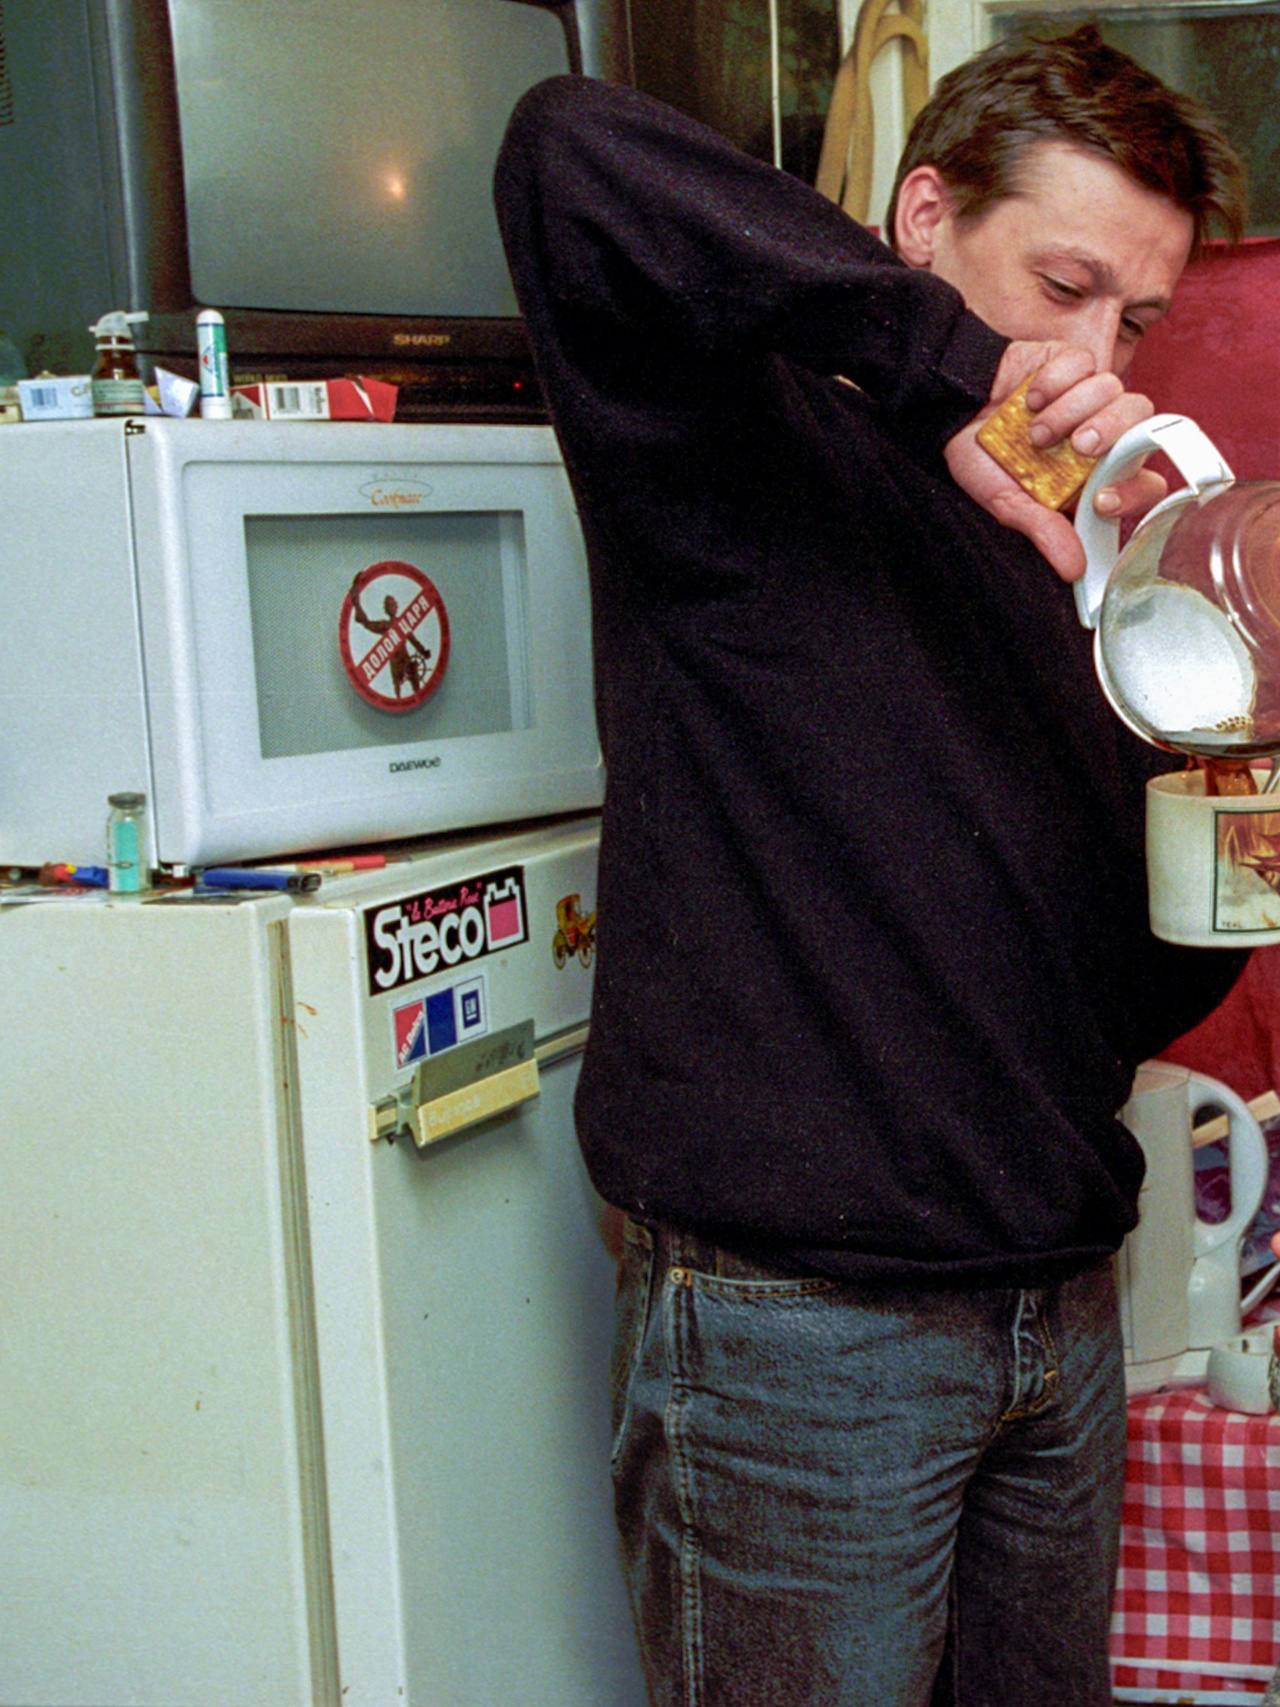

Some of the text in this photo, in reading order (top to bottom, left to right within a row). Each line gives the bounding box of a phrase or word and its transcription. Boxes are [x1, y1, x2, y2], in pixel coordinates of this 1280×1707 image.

[393, 333, 450, 346] SHARP
[361, 628, 401, 680] ДОЛОЙ
[398, 595, 431, 633] ЦАРЯ
[389, 757, 441, 773] DAEWOO
[374, 905, 485, 989] Steco
